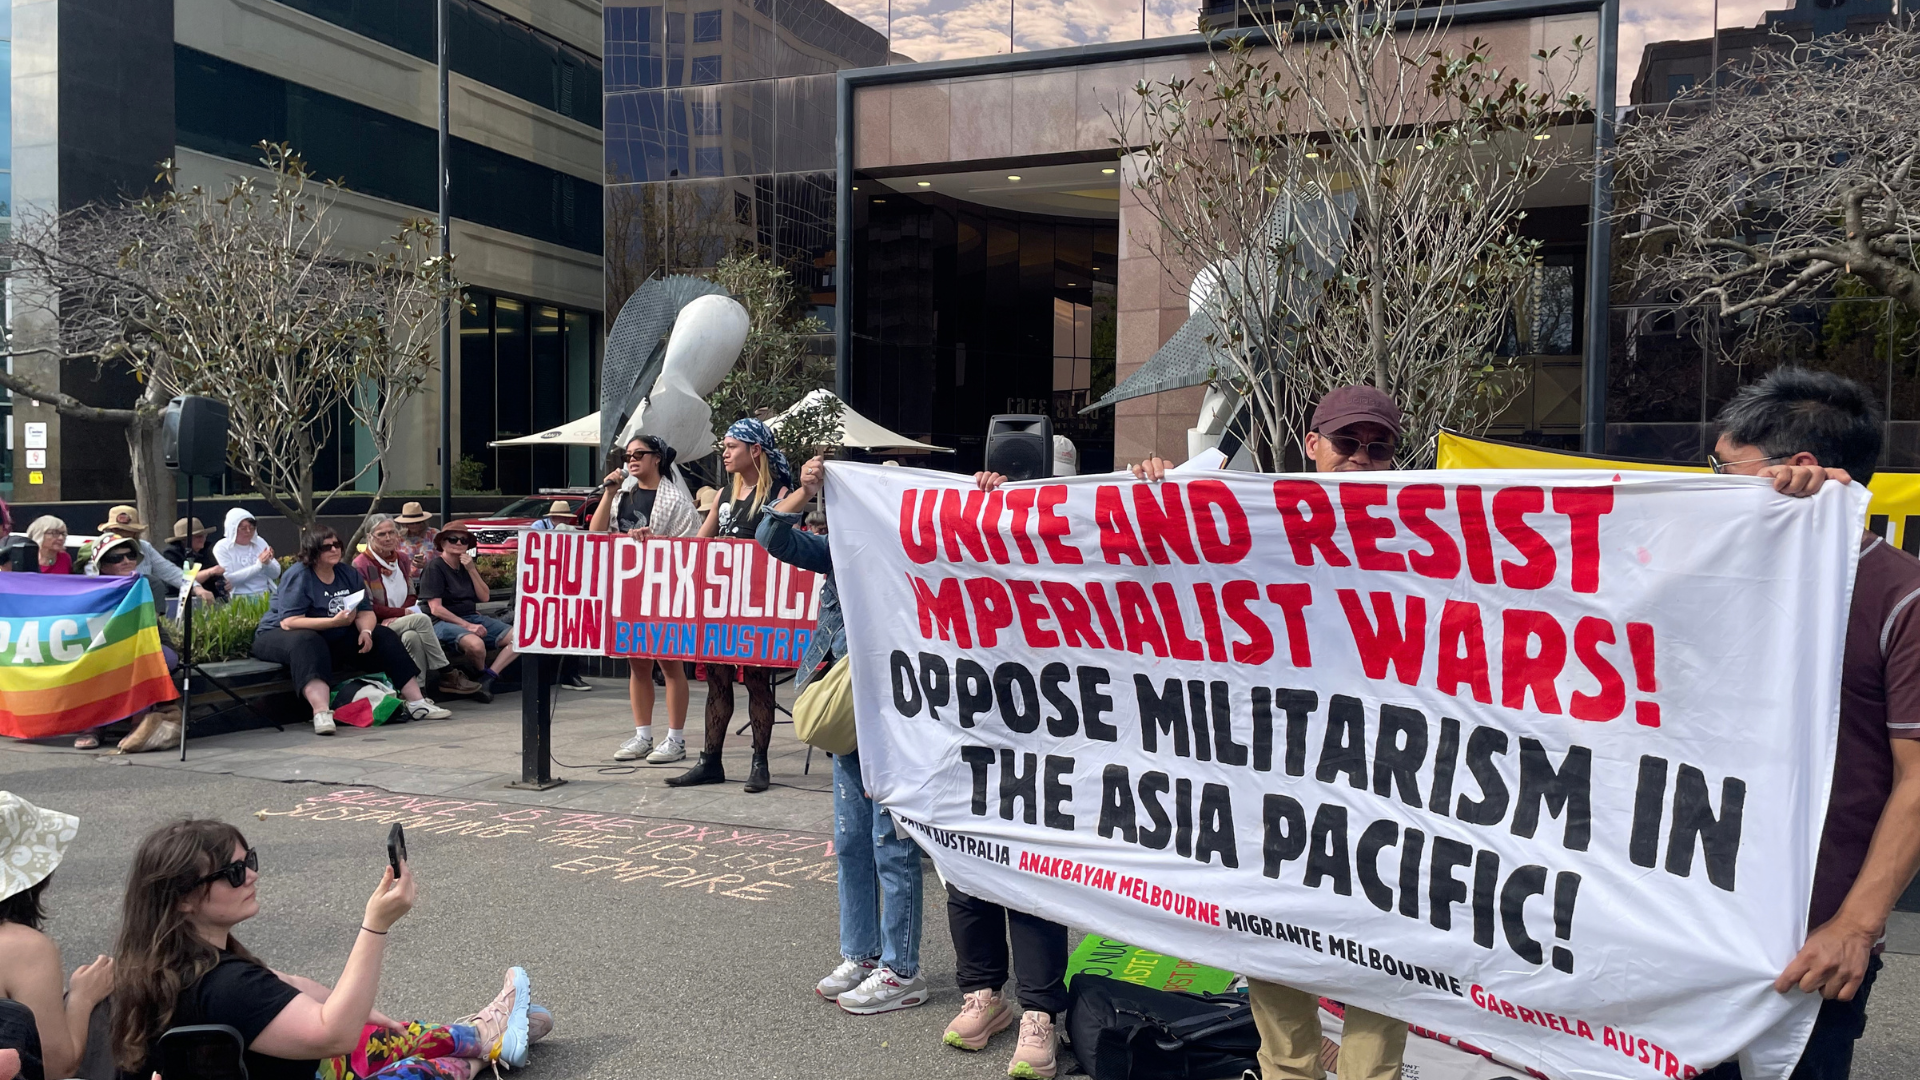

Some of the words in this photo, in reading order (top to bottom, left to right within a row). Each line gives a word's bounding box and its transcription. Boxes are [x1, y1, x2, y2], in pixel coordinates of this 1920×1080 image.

[522, 531, 609, 597] SHUT
[900, 484, 1084, 565] UNITE
[1095, 480, 1252, 566] AND
[1273, 479, 1614, 594] RESIST
[611, 537, 698, 619] PAX
[518, 595, 603, 649] DOWN
[615, 621, 696, 656] BAYAN
[703, 623, 817, 662] AUSTRA
[904, 571, 1313, 667] MPERIALIST
[1335, 588, 1661, 728] WARS!
[890, 650, 1118, 743] OPPOSE
[1133, 673, 1593, 852] MILITARISM
[1629, 754, 1747, 892] IN
[306, 789, 498, 817] SILENCE
[490, 808, 551, 822] IS
[542, 812, 648, 832] THE
[538, 829, 635, 849] THE
[551, 855, 795, 901] EMPIRE
[961, 745, 1076, 831] THE
[1098, 763, 1240, 869] ASIA
[1263, 793, 1583, 975] PACIFIC!
[933, 827, 1010, 866] AUSTRALIA
[1018, 850, 1117, 892] ANAKBAYAN
[1118, 874, 1221, 927] MELBOURNE
[1225, 909, 1323, 953] MIGRANTE
[1328, 934, 1464, 997] MELBOURNE
[1470, 983, 1595, 1041] GABRIELA
[1603, 1025, 1708, 1080] AUSTRA
[1119, 957, 1159, 986] ASTE
